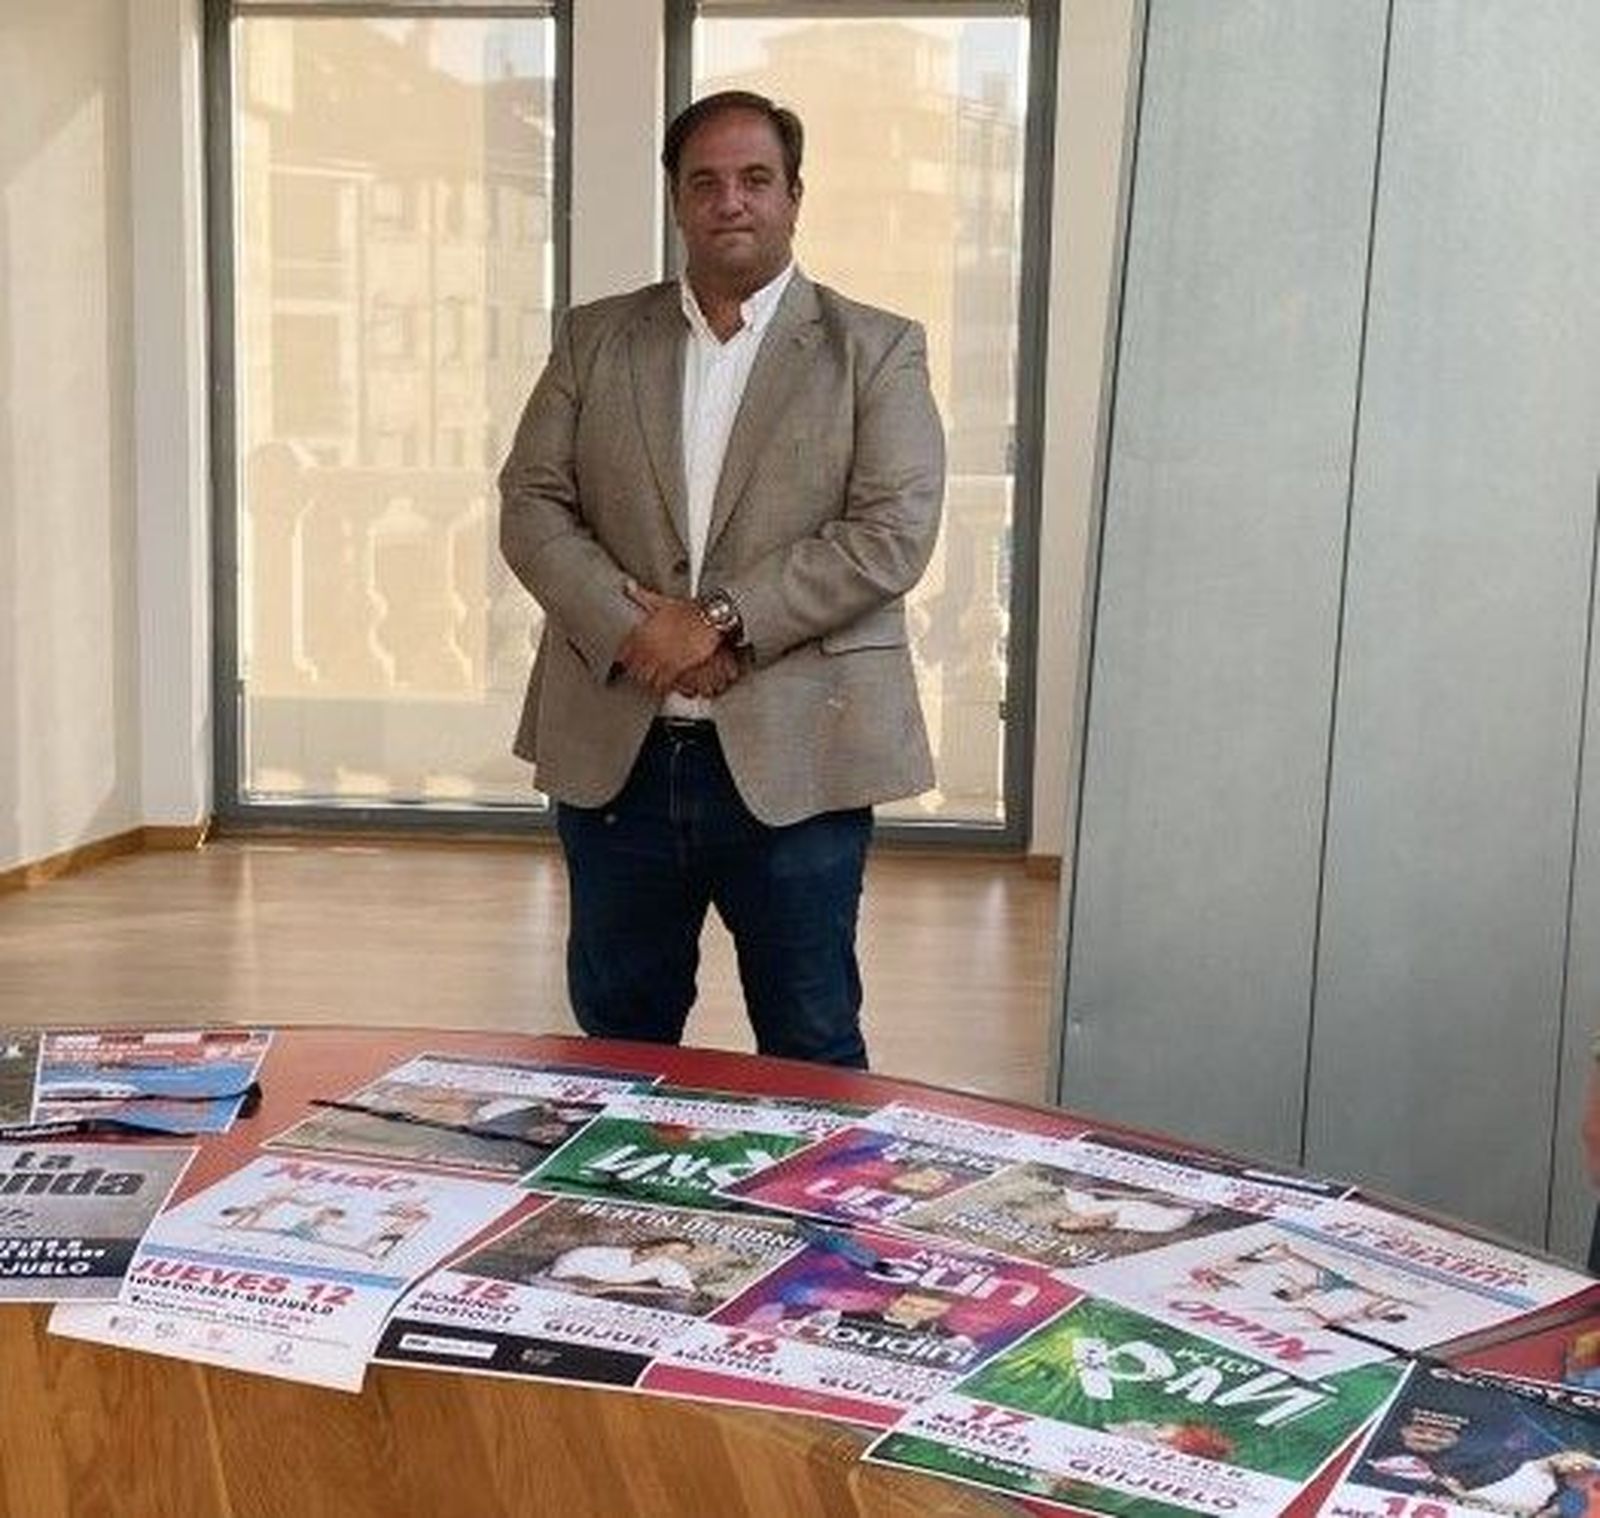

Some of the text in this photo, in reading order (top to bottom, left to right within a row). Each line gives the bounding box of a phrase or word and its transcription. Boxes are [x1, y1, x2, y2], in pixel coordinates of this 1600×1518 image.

[131, 1257, 355, 1307] JUEVES 12
[457, 1278, 517, 1301] 15
[543, 1317, 663, 1351] GUIJUEL
